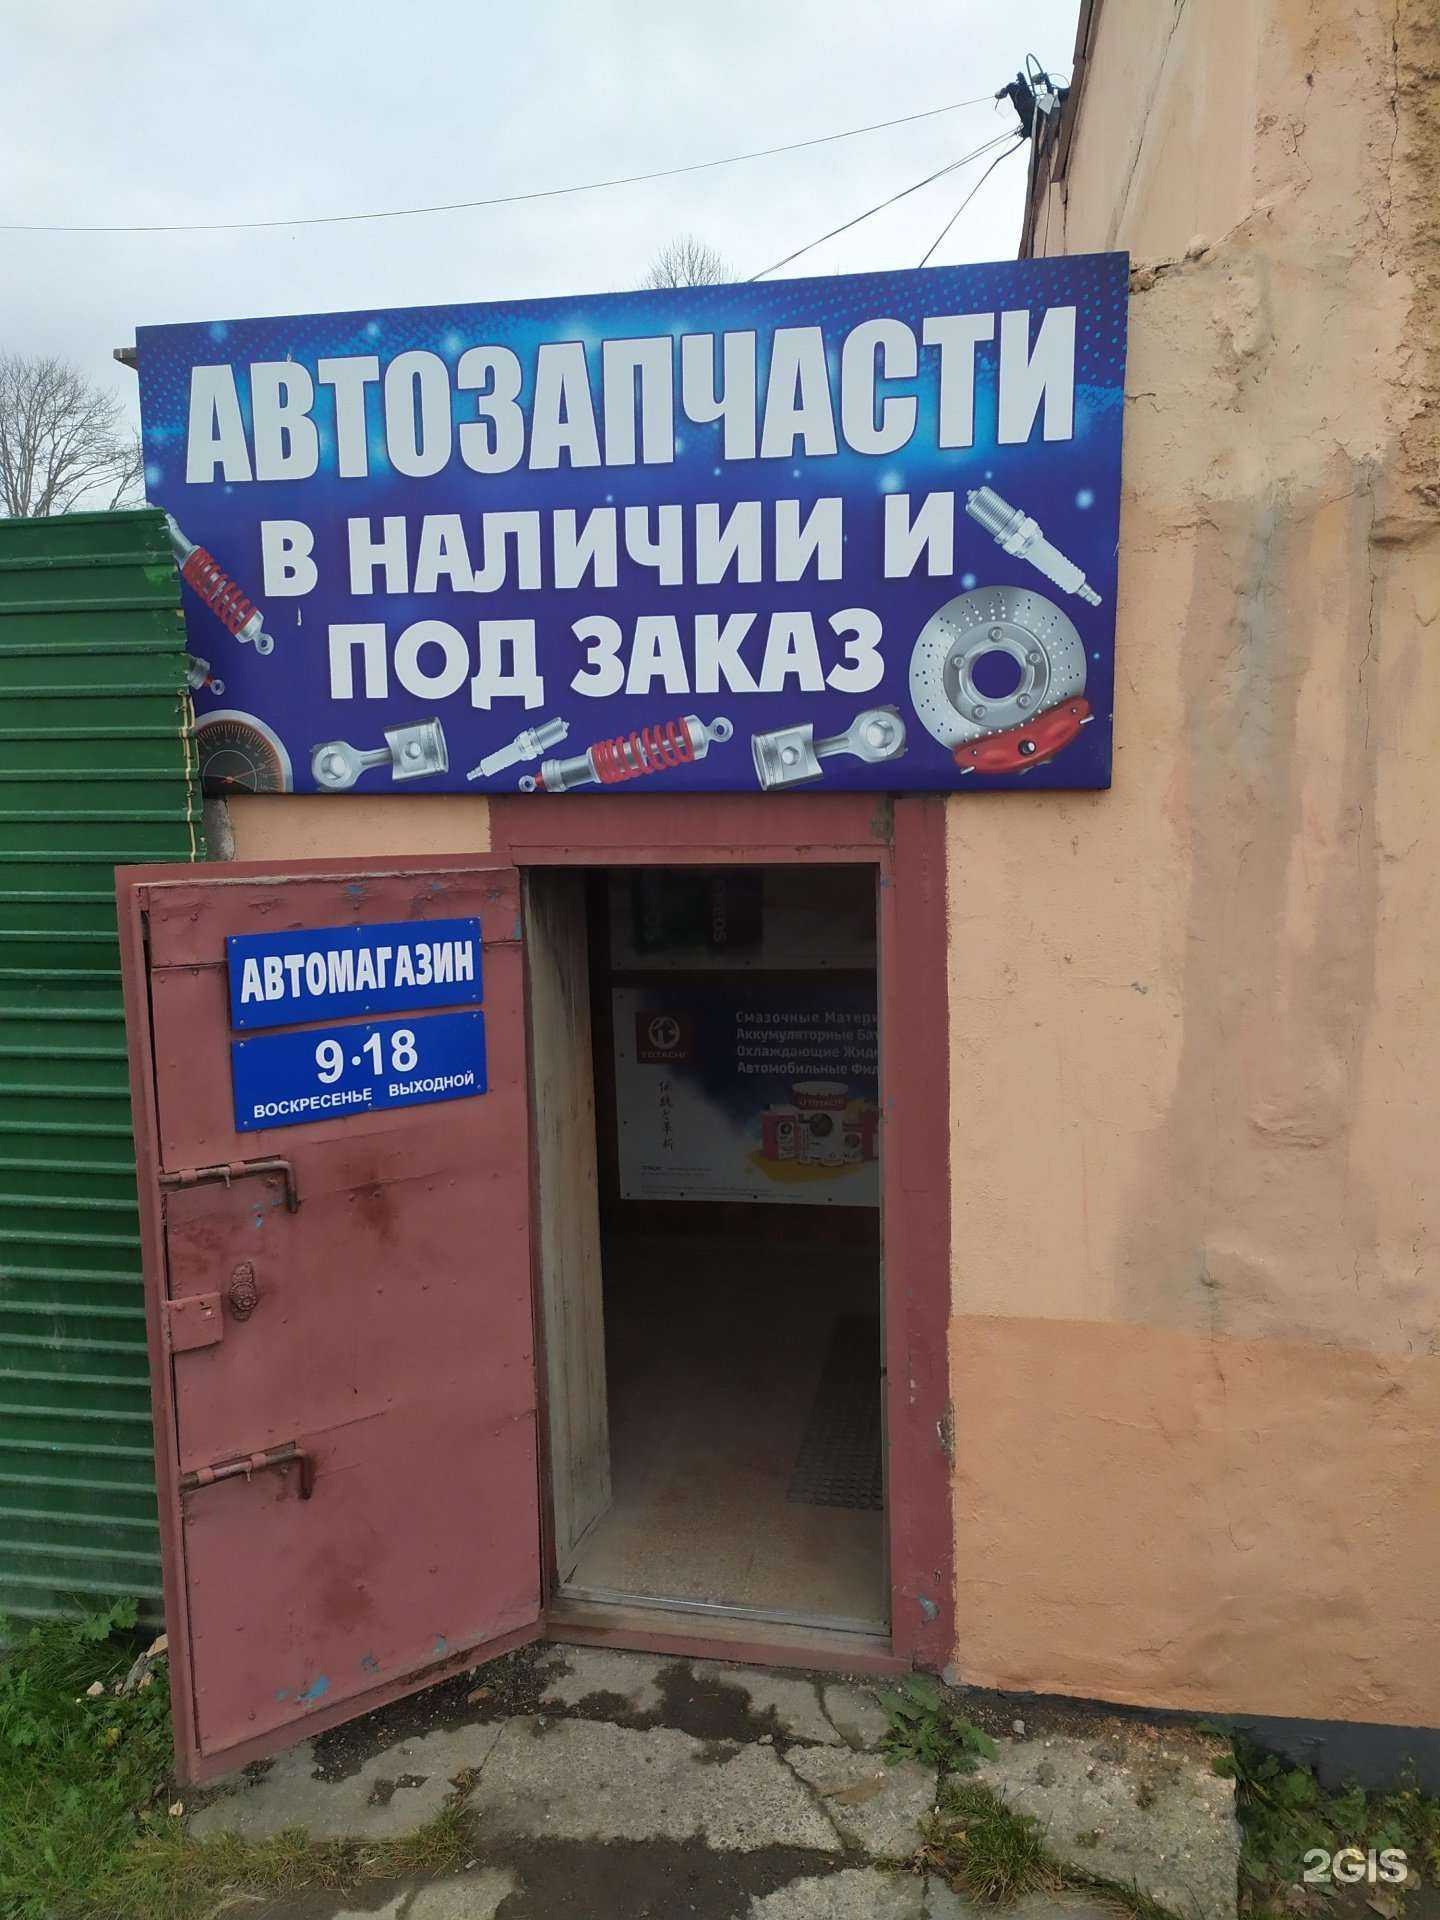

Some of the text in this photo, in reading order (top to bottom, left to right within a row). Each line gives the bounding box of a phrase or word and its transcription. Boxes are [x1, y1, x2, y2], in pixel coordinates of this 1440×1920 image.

[185, 306, 1076, 485] АВТОЗАПЧАСТИ
[260, 491, 955, 598] В НАЛИЧИИ И
[328, 608, 884, 711] ПОД ЗАКАЗ
[240, 940, 474, 1004] АВТОМАГАЗИН
[253, 1070, 475, 1119] ВОСКРЕСЕНЬЕ ВЫХОДНОЙ
[737, 1061, 848, 1075] Автомобильные
